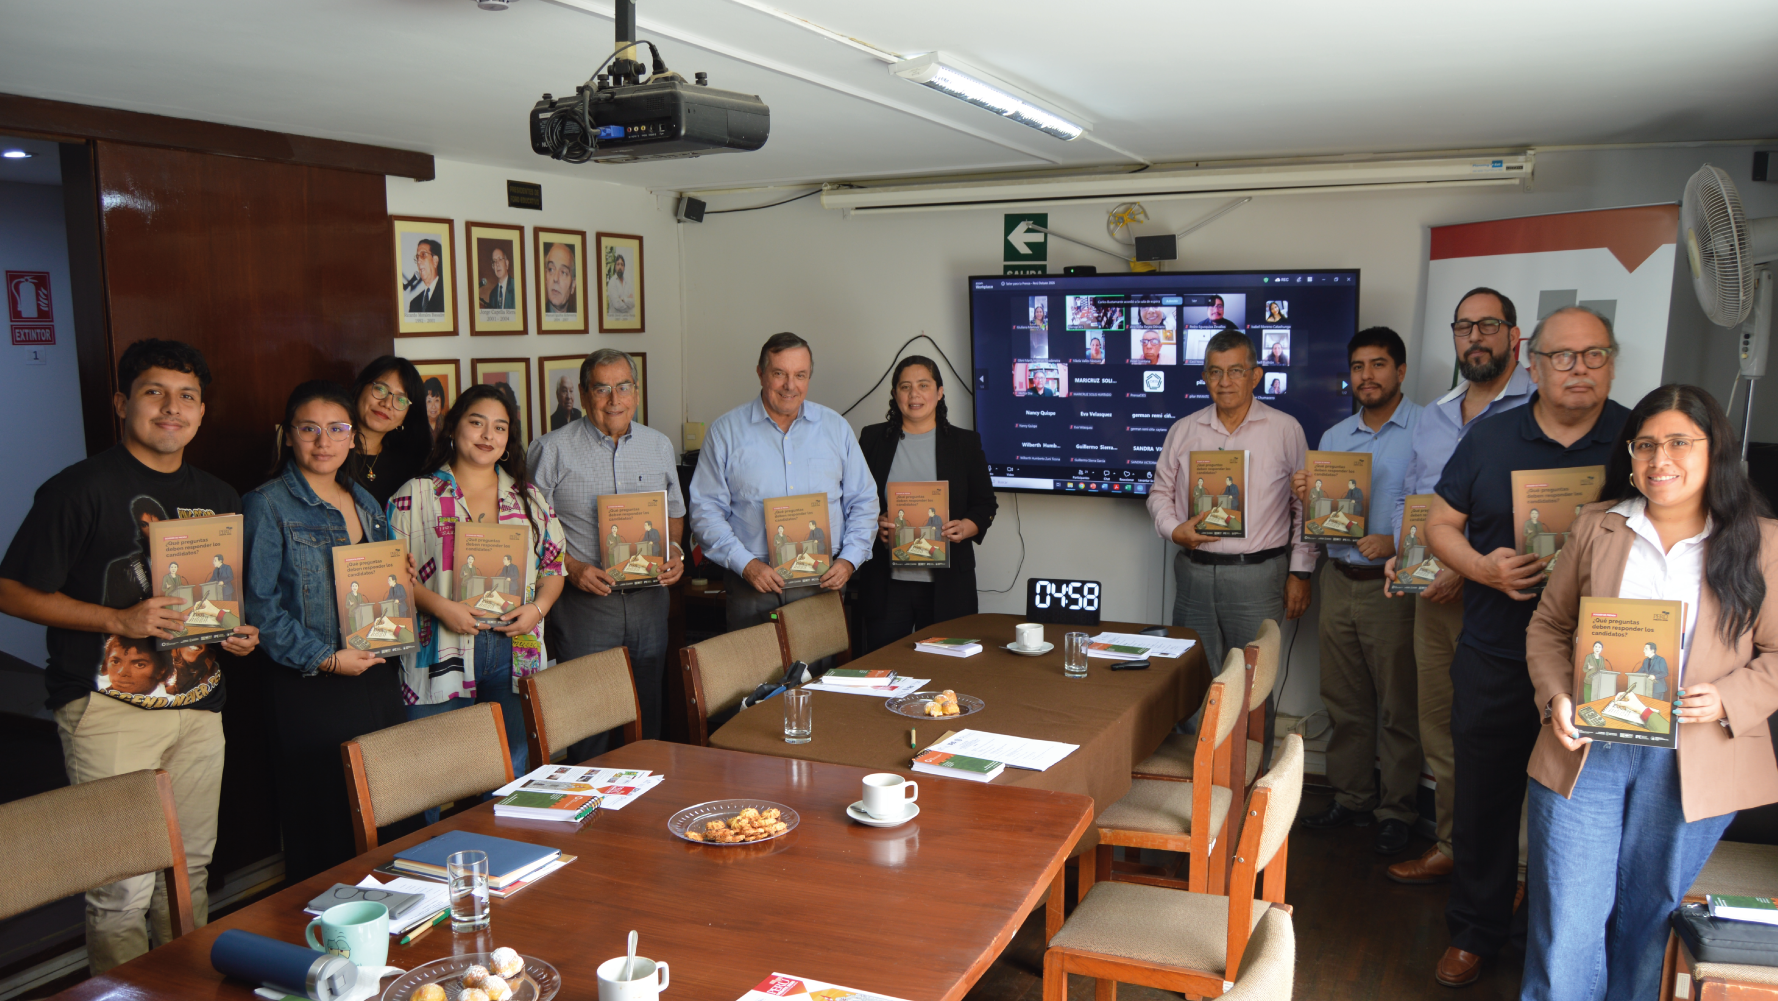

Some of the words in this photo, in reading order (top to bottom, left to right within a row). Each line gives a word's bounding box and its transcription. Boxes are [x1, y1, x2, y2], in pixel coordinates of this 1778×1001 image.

[15, 329, 52, 341] EXTINTOR
[33, 350, 39, 360] 1
[180, 538, 208, 546] preguntas
[185, 542, 212, 551] responder
[1035, 580, 1099, 611] 04:58
[171, 684, 209, 707] NEVER
